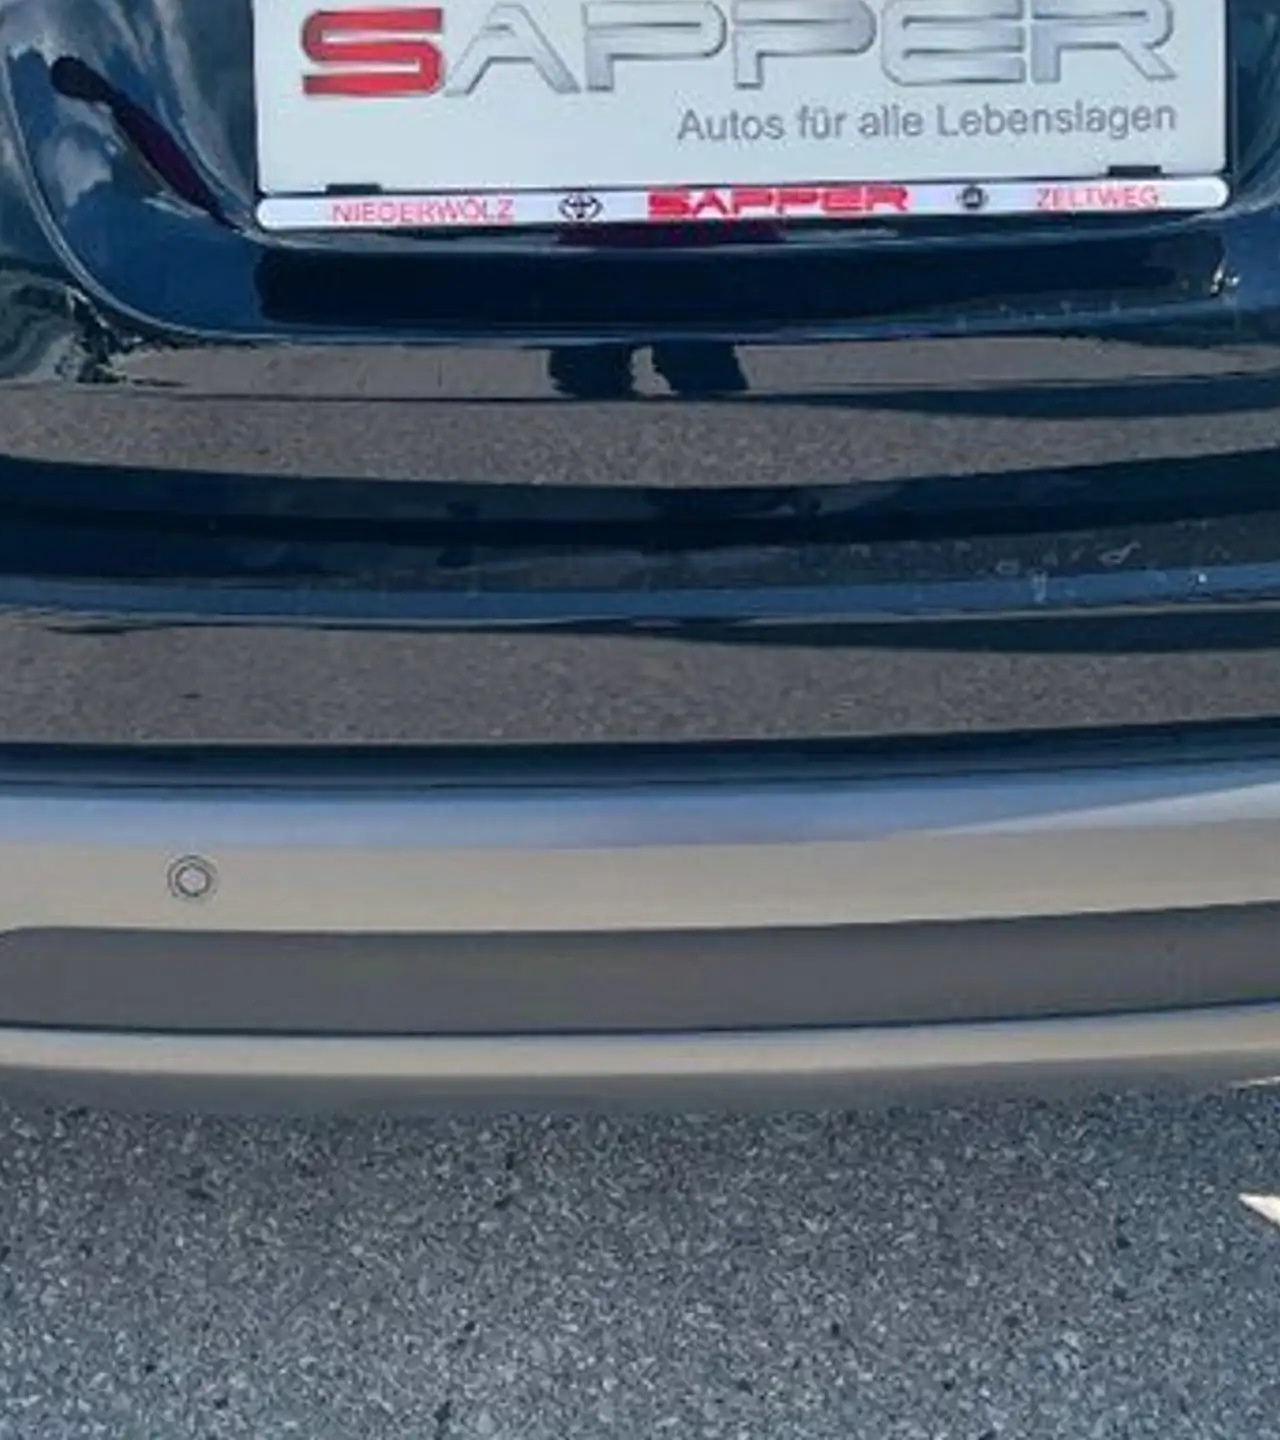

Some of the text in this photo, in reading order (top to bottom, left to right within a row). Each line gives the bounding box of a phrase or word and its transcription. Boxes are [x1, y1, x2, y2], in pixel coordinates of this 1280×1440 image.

[677, 99, 1178, 141] Autos für alle Lebenslagen
[647, 184, 909, 221] SAPPER
[1036, 185, 1160, 211] ZELTWEG
